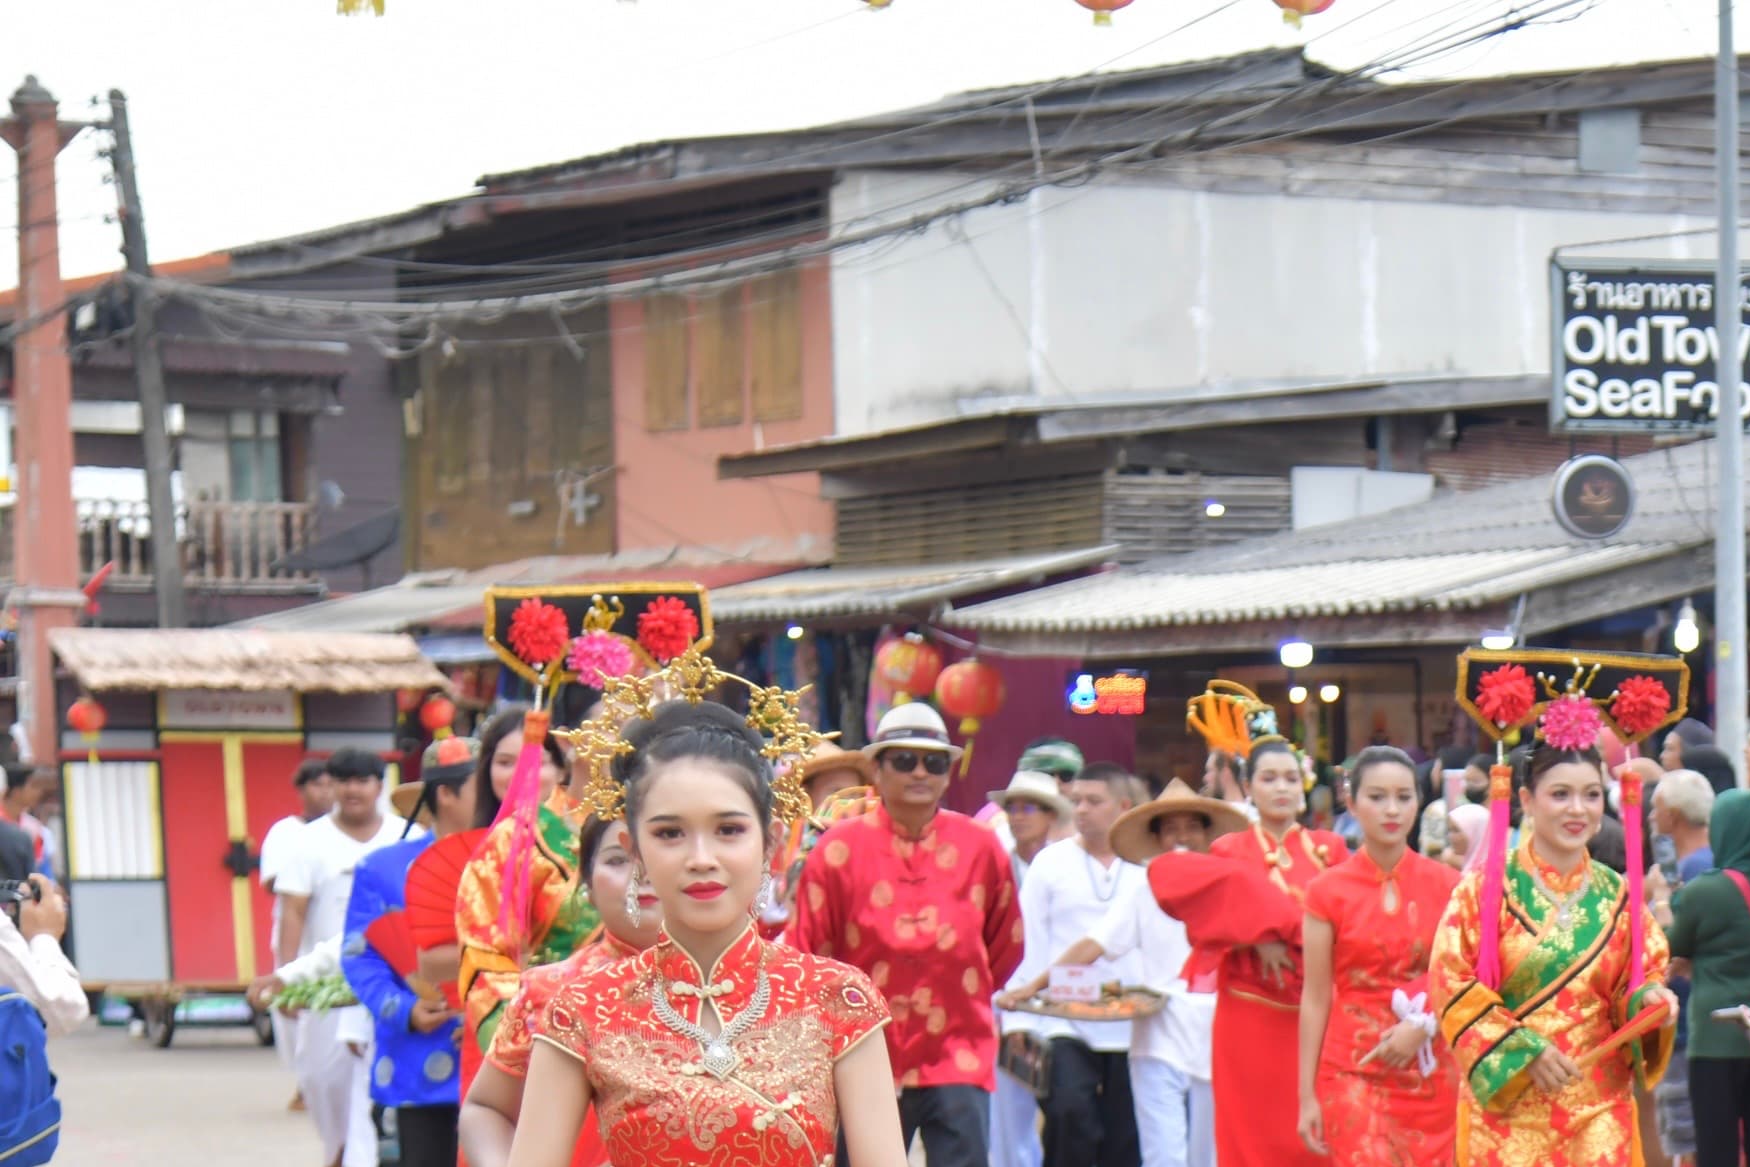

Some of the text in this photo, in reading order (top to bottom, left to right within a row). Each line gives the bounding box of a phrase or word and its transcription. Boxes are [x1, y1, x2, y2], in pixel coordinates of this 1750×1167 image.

[1567, 271, 1713, 311] ร้านอาหาร
[1564, 315, 1650, 365] Old
